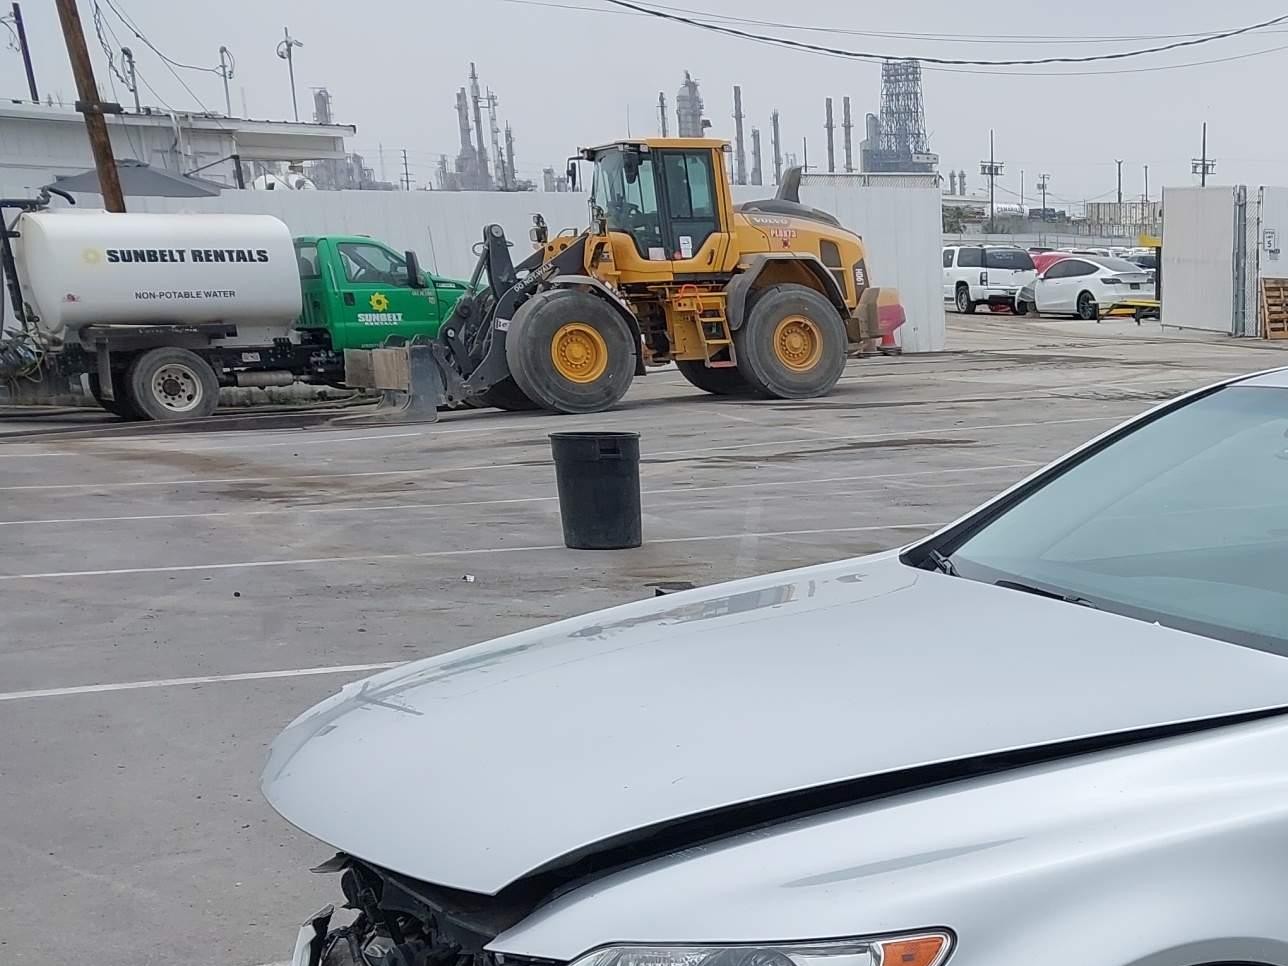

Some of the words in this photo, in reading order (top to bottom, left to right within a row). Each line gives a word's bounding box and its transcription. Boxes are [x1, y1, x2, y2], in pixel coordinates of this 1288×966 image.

[752, 216, 788, 225] VOLVO
[106, 249, 186, 263] SUNBELT
[190, 249, 269, 263] RENTALS
[855, 268, 865, 286] L90H
[135, 290, 202, 300] NON-POTABLE
[203, 290, 236, 299] WATER
[357, 312, 403, 322] SUNBELT
